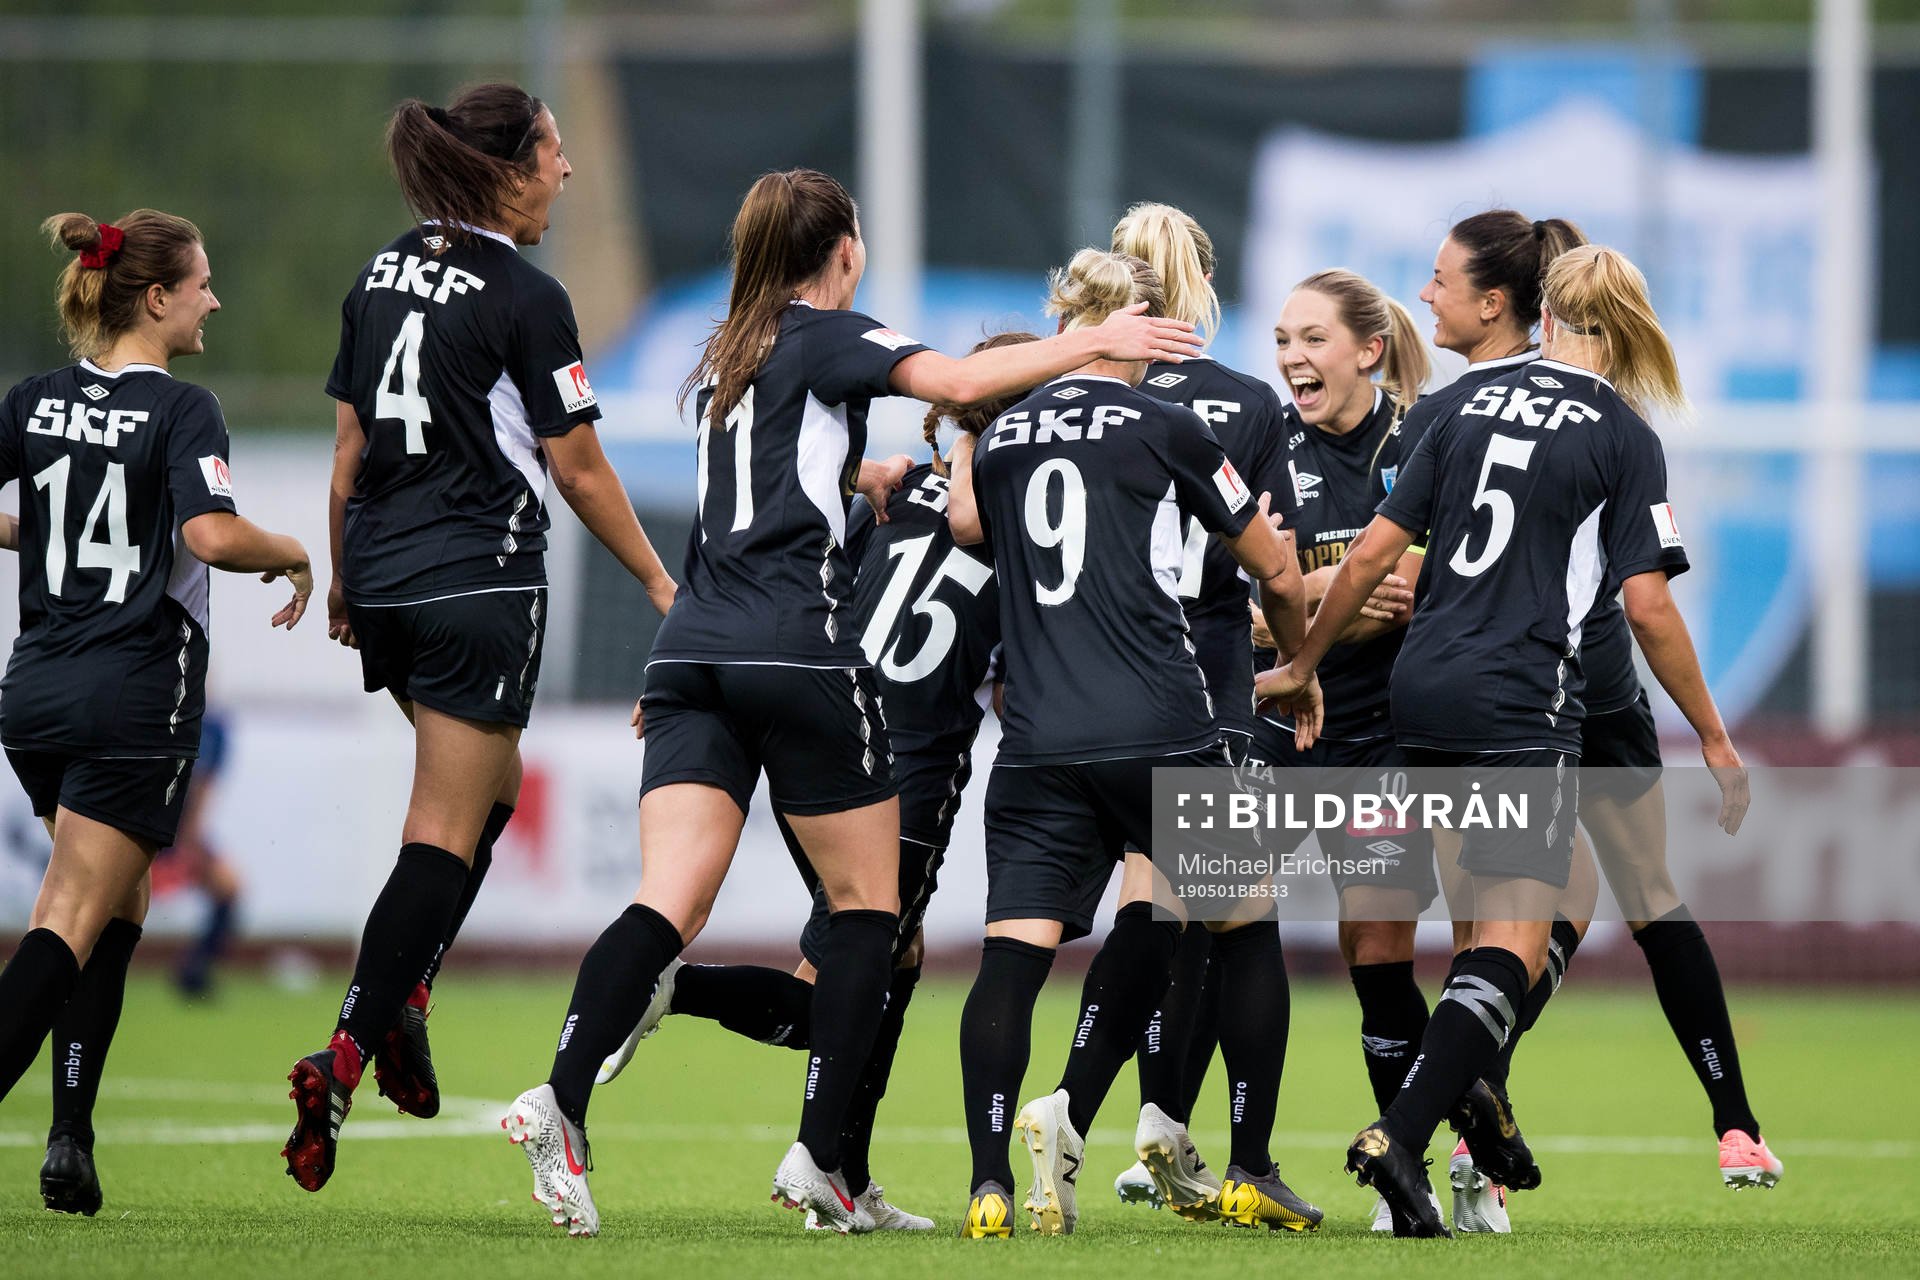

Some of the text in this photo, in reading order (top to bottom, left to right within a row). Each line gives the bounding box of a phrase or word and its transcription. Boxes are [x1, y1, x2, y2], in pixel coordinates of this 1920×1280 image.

[365, 251, 485, 305] SKF
[375, 310, 432, 455] 4
[26, 397, 149, 448] SKF
[988, 405, 1142, 452] SKF
[1461, 385, 1602, 432] SKF
[1449, 432, 1537, 578] 5
[33, 454, 141, 603] 14
[1024, 457, 1088, 606] 9
[859, 531, 994, 683] 15
[341, 985, 361, 1019] umbro
[558, 1014, 579, 1051] umbro
[1074, 1004, 1100, 1048] umbro
[64, 1042, 82, 1087] umbro
[806, 1056, 821, 1100] umbro
[1401, 1054, 1425, 1088] umbro
[1700, 1038, 1723, 1080] umbro
[988, 1093, 1005, 1132] umbro
[1233, 1081, 1247, 1123] umbro
